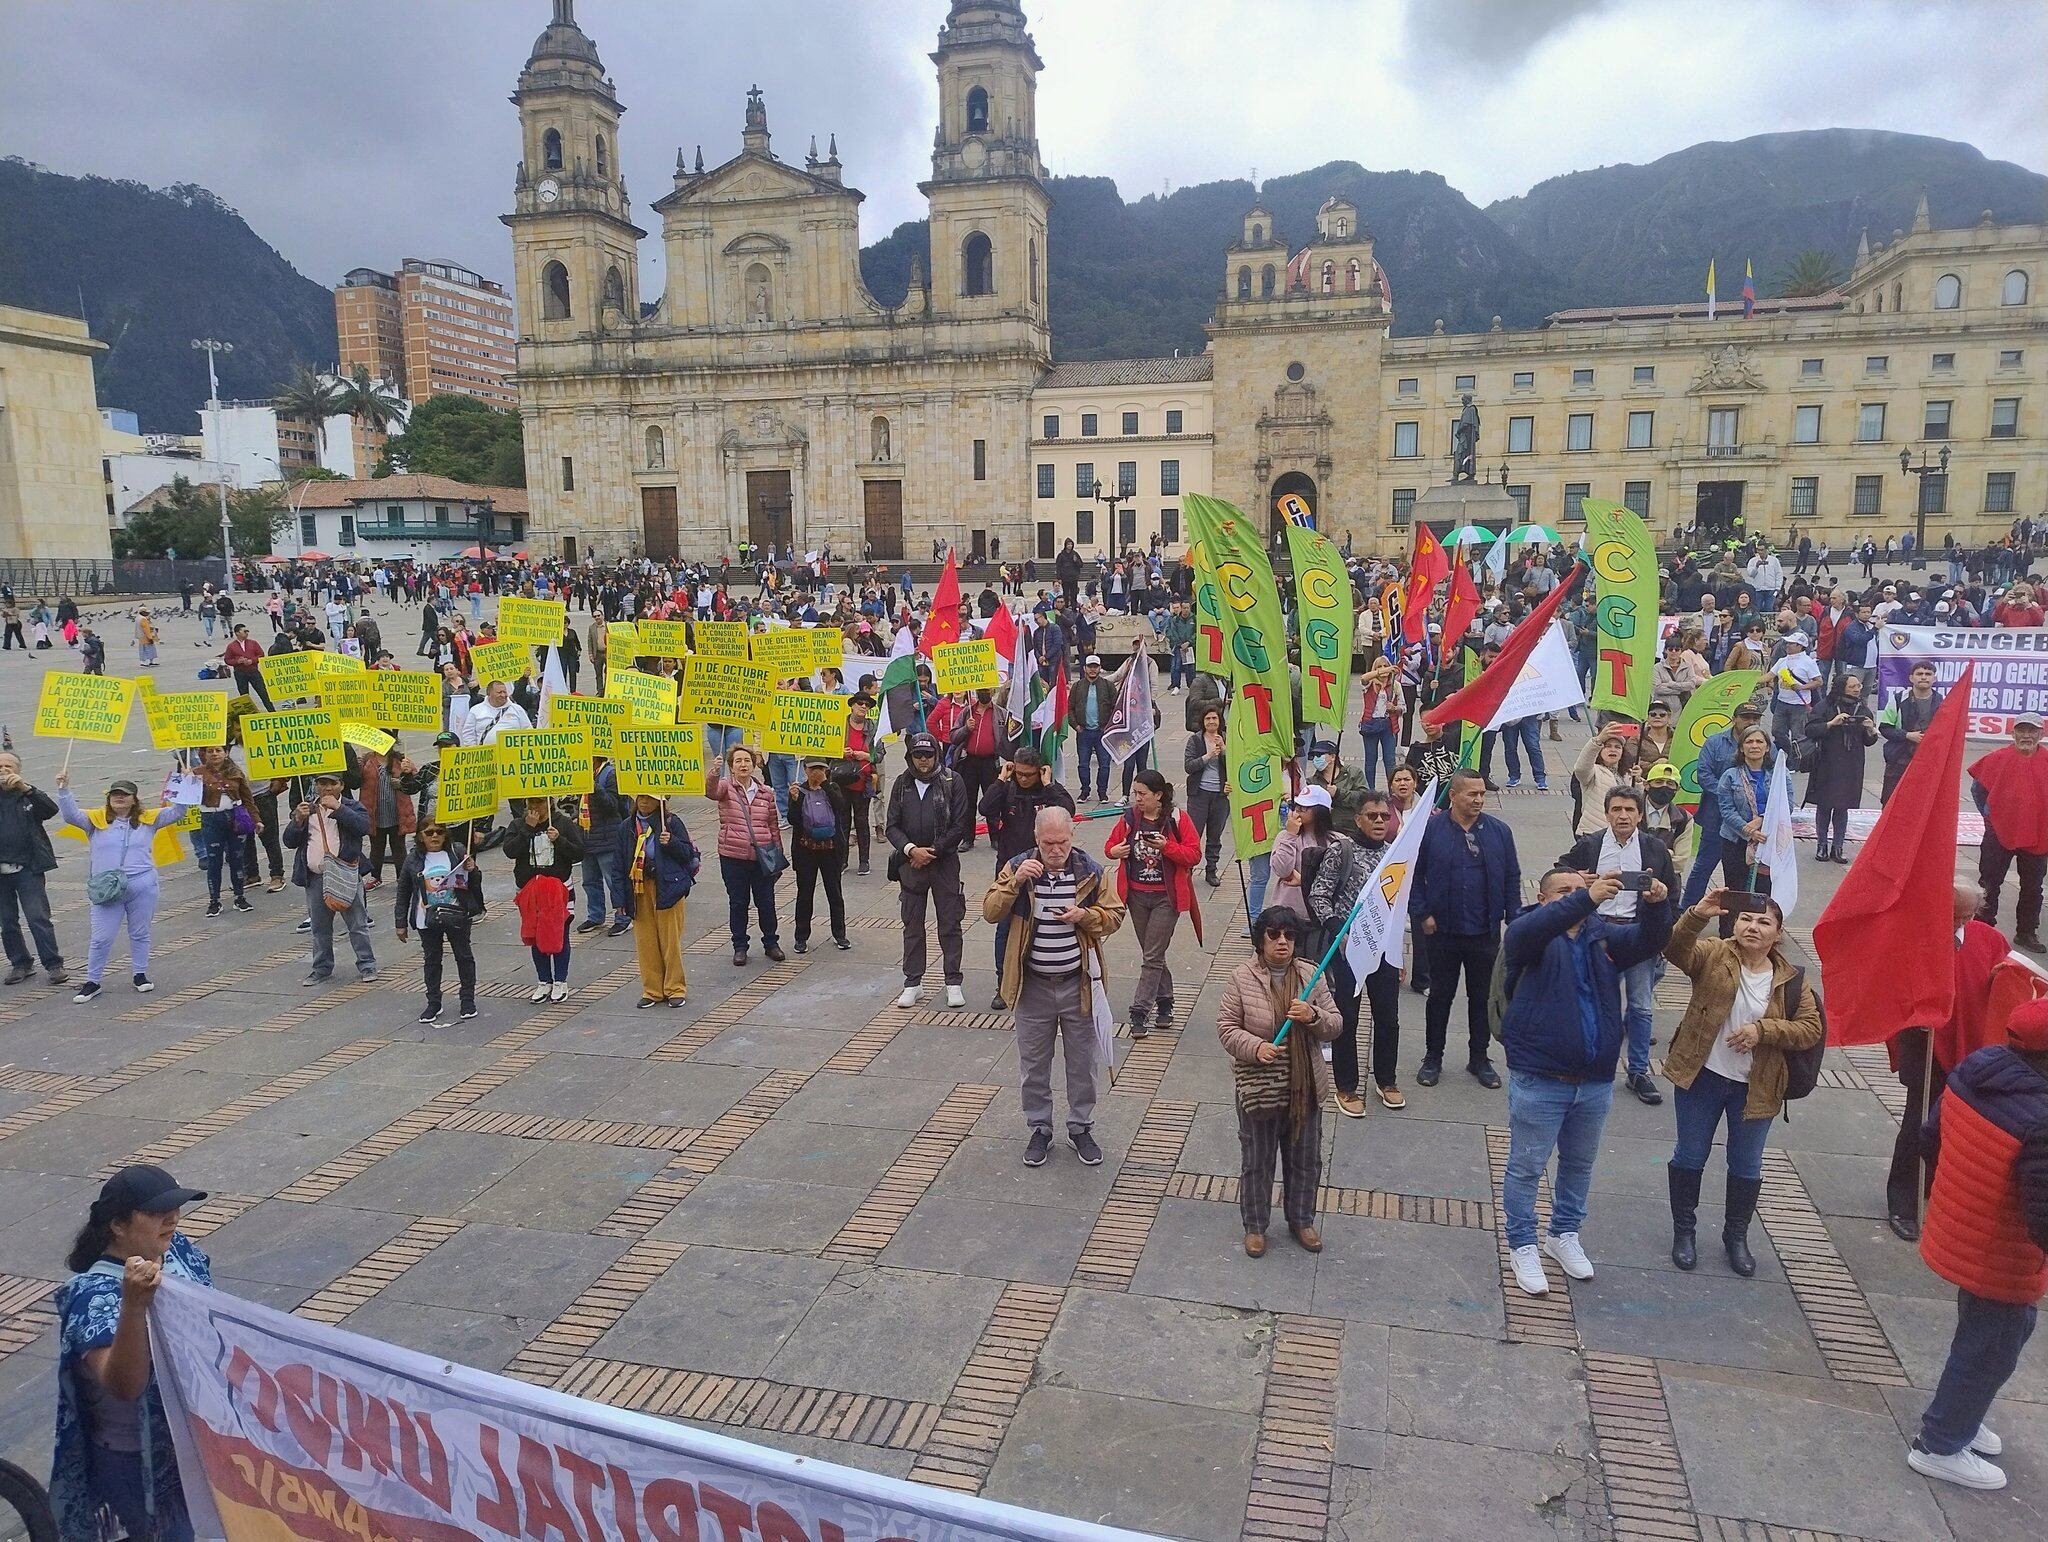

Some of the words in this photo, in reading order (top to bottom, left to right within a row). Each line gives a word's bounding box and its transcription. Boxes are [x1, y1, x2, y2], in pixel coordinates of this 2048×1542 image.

[503, 602, 514, 611] SOY
[517, 604, 561, 616] SOBREVIVIENTE
[501, 614, 510, 623] DEL
[513, 615, 539, 625] GENOCIDIO
[540, 618, 560, 628] CONTRA
[1593, 540, 1638, 697] CGT
[501, 627, 508, 635] LA
[643, 622, 681, 631] DEFENDEMOS
[649, 637, 683, 646] DEMOCRACIA
[776, 635, 806, 643] OCTUBRE
[1300, 567, 1339, 710] CGT
[475, 642, 522, 657] DEFENDEMOS
[938, 644, 990, 658] DEFENDEMOS
[265, 655, 309, 668] DEFENDEMOS
[314, 662, 329, 671] LAS
[323, 655, 359, 669] APOYAMOS
[477, 665, 486, 674] LA
[488, 656, 530, 672] DEMOCRACIA
[948, 658, 958, 666] LA
[497, 670, 507, 678] LA
[509, 667, 522, 676] PAZ
[694, 662, 703, 672] 11
[706, 663, 718, 673] DE
[723, 664, 770, 681] OCTUBRE
[937, 669, 948, 677] LA
[950, 664, 995, 676] DEMOCRACIA
[57, 676, 120, 690] APOYAMOS
[276, 673, 315, 685] DEMOCRACIA
[377, 673, 430, 684] APOYAMOS
[614, 674, 671, 692] DEFENDEMOS
[708, 675, 740, 684] NACIONAL
[950, 677, 954, 685] Y
[958, 676, 968, 684] LA
[971, 674, 984, 683] PAZ
[295, 684, 308, 692] PAZ
[325, 681, 336, 691] SOY
[372, 684, 385, 692] LA
[388, 684, 435, 695] CONSULTA
[623, 686, 634, 694] LA
[687, 681, 716, 689] DIGNIDAD
[48, 686, 60, 695] LA
[66, 688, 123, 702] CONSULTA
[164, 695, 214, 704] APOYAMOS
[325, 695, 335, 705] DEL
[383, 694, 424, 703] POPULAR
[704, 690, 737, 699] GENOCIDIO
[740, 693, 765, 705] CONTRA
[2002, 689, 2022, 710] DE
[57, 699, 107, 711] POPULAR
[558, 700, 625, 714] DEFENDEMOS
[700, 697, 712, 705] LA
[173, 704, 220, 713] CONSULTA
[372, 702, 389, 712] DEL
[392, 704, 437, 714] GOBIERNO
[694, 706, 756, 721] PATRIÓTICA
[782, 709, 796, 719] LA
[42, 708, 58, 717] DEL
[64, 709, 121, 723] GOBIERNO
[169, 714, 209, 722] POPULAR
[377, 712, 394, 721] DEL
[397, 713, 433, 724] CAMBIO
[569, 713, 580, 722] LA
[645, 710, 660, 720] PAZ
[44, 719, 60, 729] DEL
[66, 720, 112, 733] CAMBIO
[176, 722, 221, 731] GOBIERNO
[251, 713, 331, 731] DEFENDEMOS
[781, 722, 841, 736] DEMOCRACIA
[180, 732, 217, 740] CAMBIO
[266, 732, 282, 743] LA
[505, 733, 583, 747] DEFENDEMOS
[621, 731, 693, 743] DEFENDEMOS
[780, 734, 785, 744] Y
[789, 735, 803, 746] LA
[807, 736, 825, 747] PAZ
[249, 747, 264, 758] LA
[268, 739, 339, 756] DEMOCRACIA
[594, 739, 612, 749] PAZ
[454, 750, 493, 765] APOYAMOS
[520, 749, 536, 761] LA
[634, 746, 648, 757] LA
[269, 759, 276, 769] Y
[282, 756, 298, 768] LA
[303, 754, 324, 765] PAZ
[502, 764, 515, 775] LA
[520, 760, 589, 774] DEMOCRACIA
[619, 761, 632, 771] LA
[635, 759, 700, 771] DEMOCRACIA
[443, 768, 460, 782] LAS
[637, 774, 642, 785] Y
[647, 774, 661, 785] LA
[665, 774, 684, 785] PAZ
[445, 782, 461, 796] DEL
[465, 778, 496, 794] GOBIERNO
[521, 777, 527, 788] Y
[533, 776, 547, 787] LA
[553, 775, 572, 786] PAZ
[448, 798, 464, 812] DEL
[467, 795, 492, 809] CAMBIO
